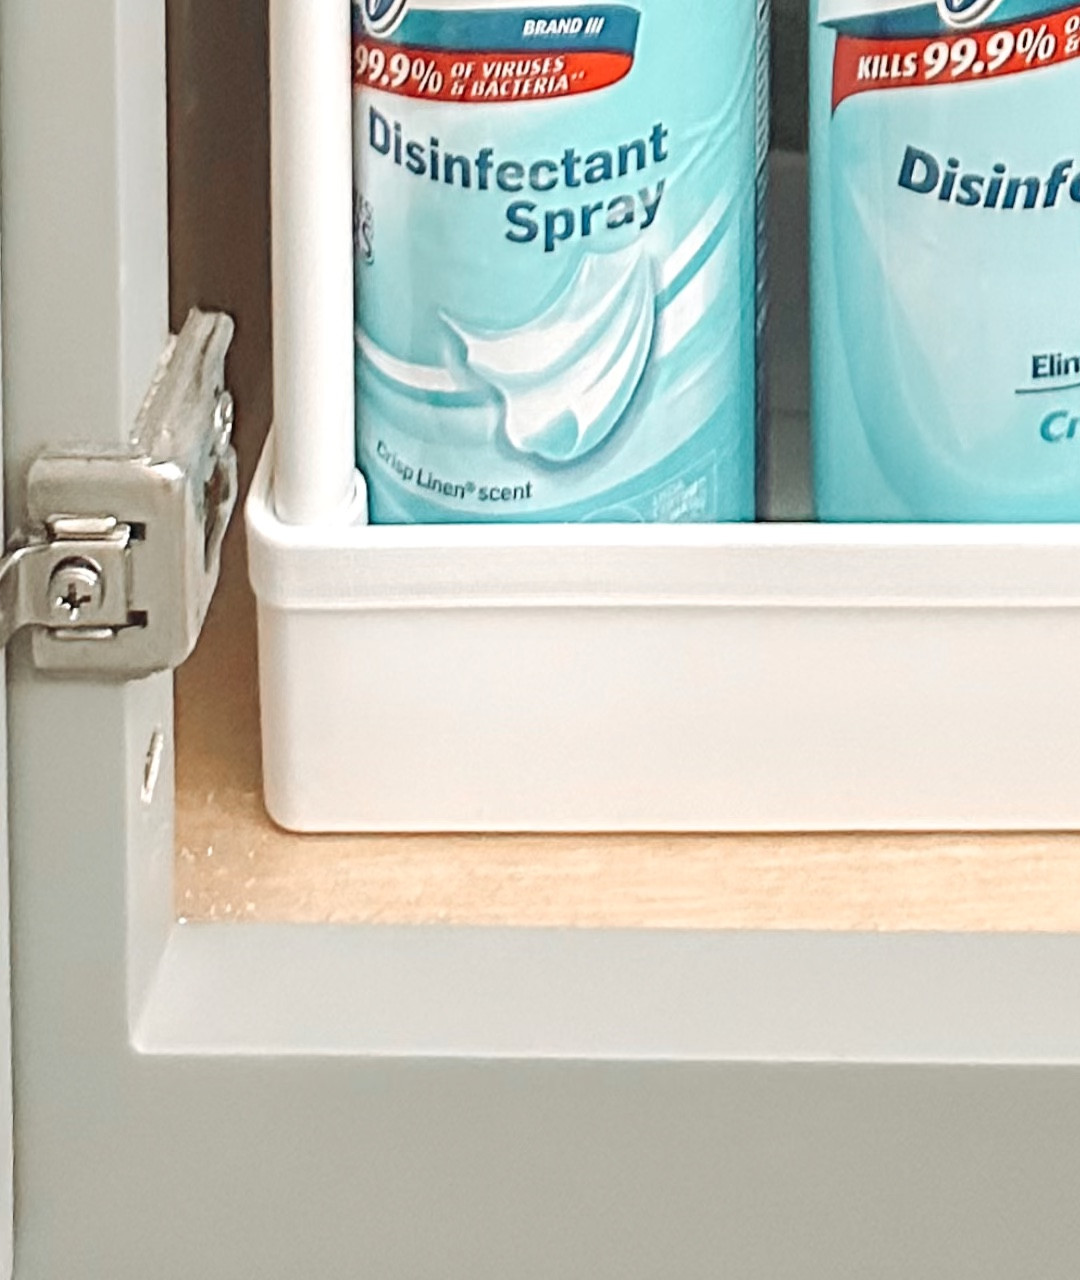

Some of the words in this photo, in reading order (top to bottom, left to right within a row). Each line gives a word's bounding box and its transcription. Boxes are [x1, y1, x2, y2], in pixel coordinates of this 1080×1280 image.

[522, 17, 583, 37] BRAND
[857, 52, 918, 80] KILLS
[923, 24, 1057, 80] 99.9%
[1064, 34, 1080, 53] &
[355, 43, 444, 94] 99.9%
[450, 79, 465, 96] &
[451, 61, 475, 80] OF
[482, 55, 566, 80] VIRUSES
[368, 105, 669, 193] Disinfectant
[504, 178, 667, 253] Spray
[376, 439, 415, 481] Crisp
[478, 481, 533, 502] scent
